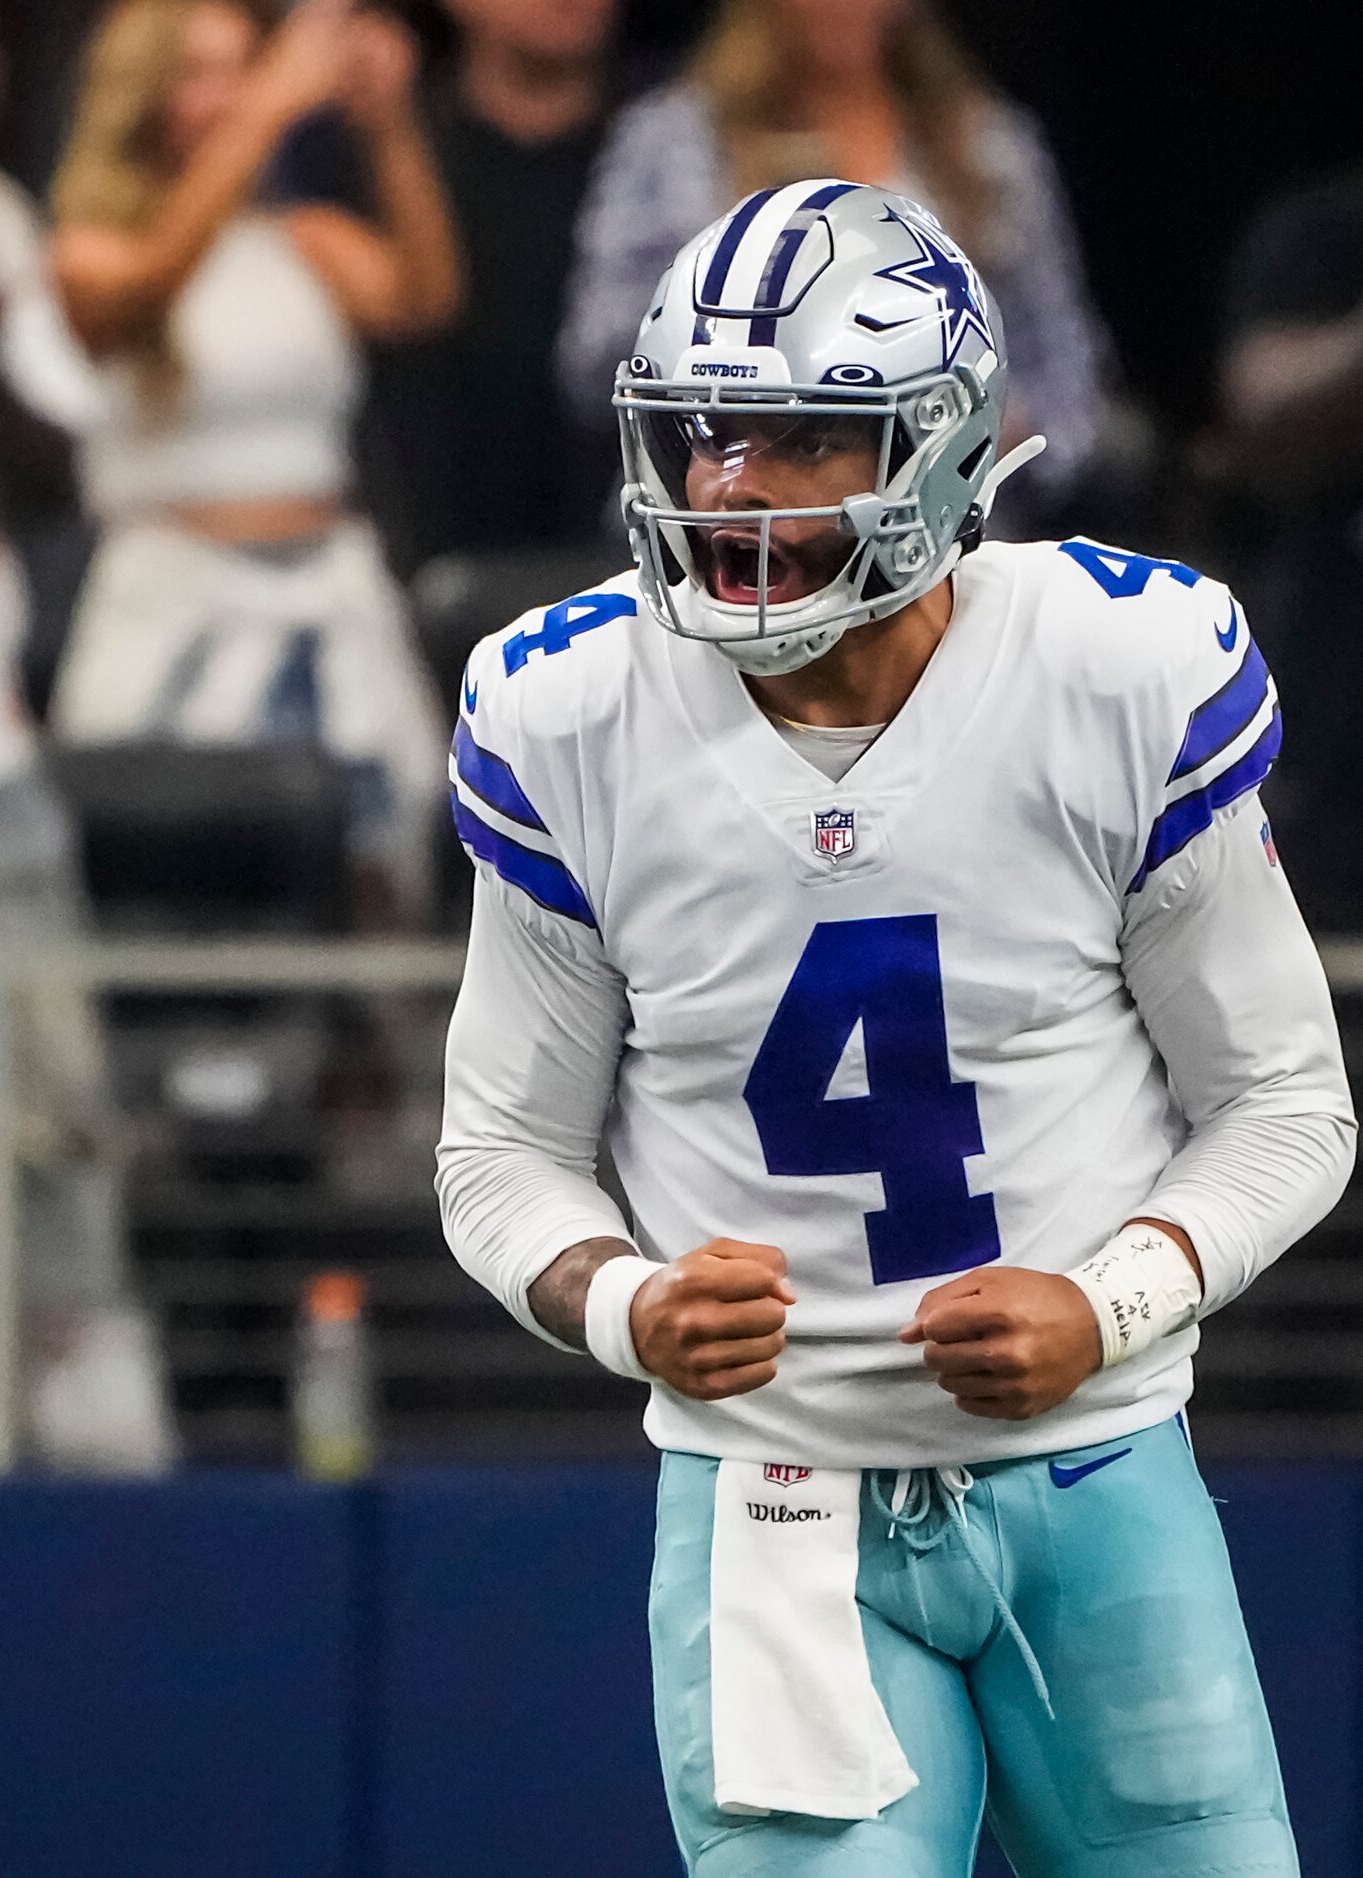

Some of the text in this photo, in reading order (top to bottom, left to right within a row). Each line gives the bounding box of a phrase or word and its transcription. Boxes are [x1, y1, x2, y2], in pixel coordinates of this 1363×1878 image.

[691, 363, 758, 378] COWBOYS
[1057, 541, 1203, 598] 4
[503, 593, 638, 678] 4
[819, 830, 850, 851] NFL
[743, 913, 1001, 1286] 4
[746, 1502, 821, 1523] Wilson
